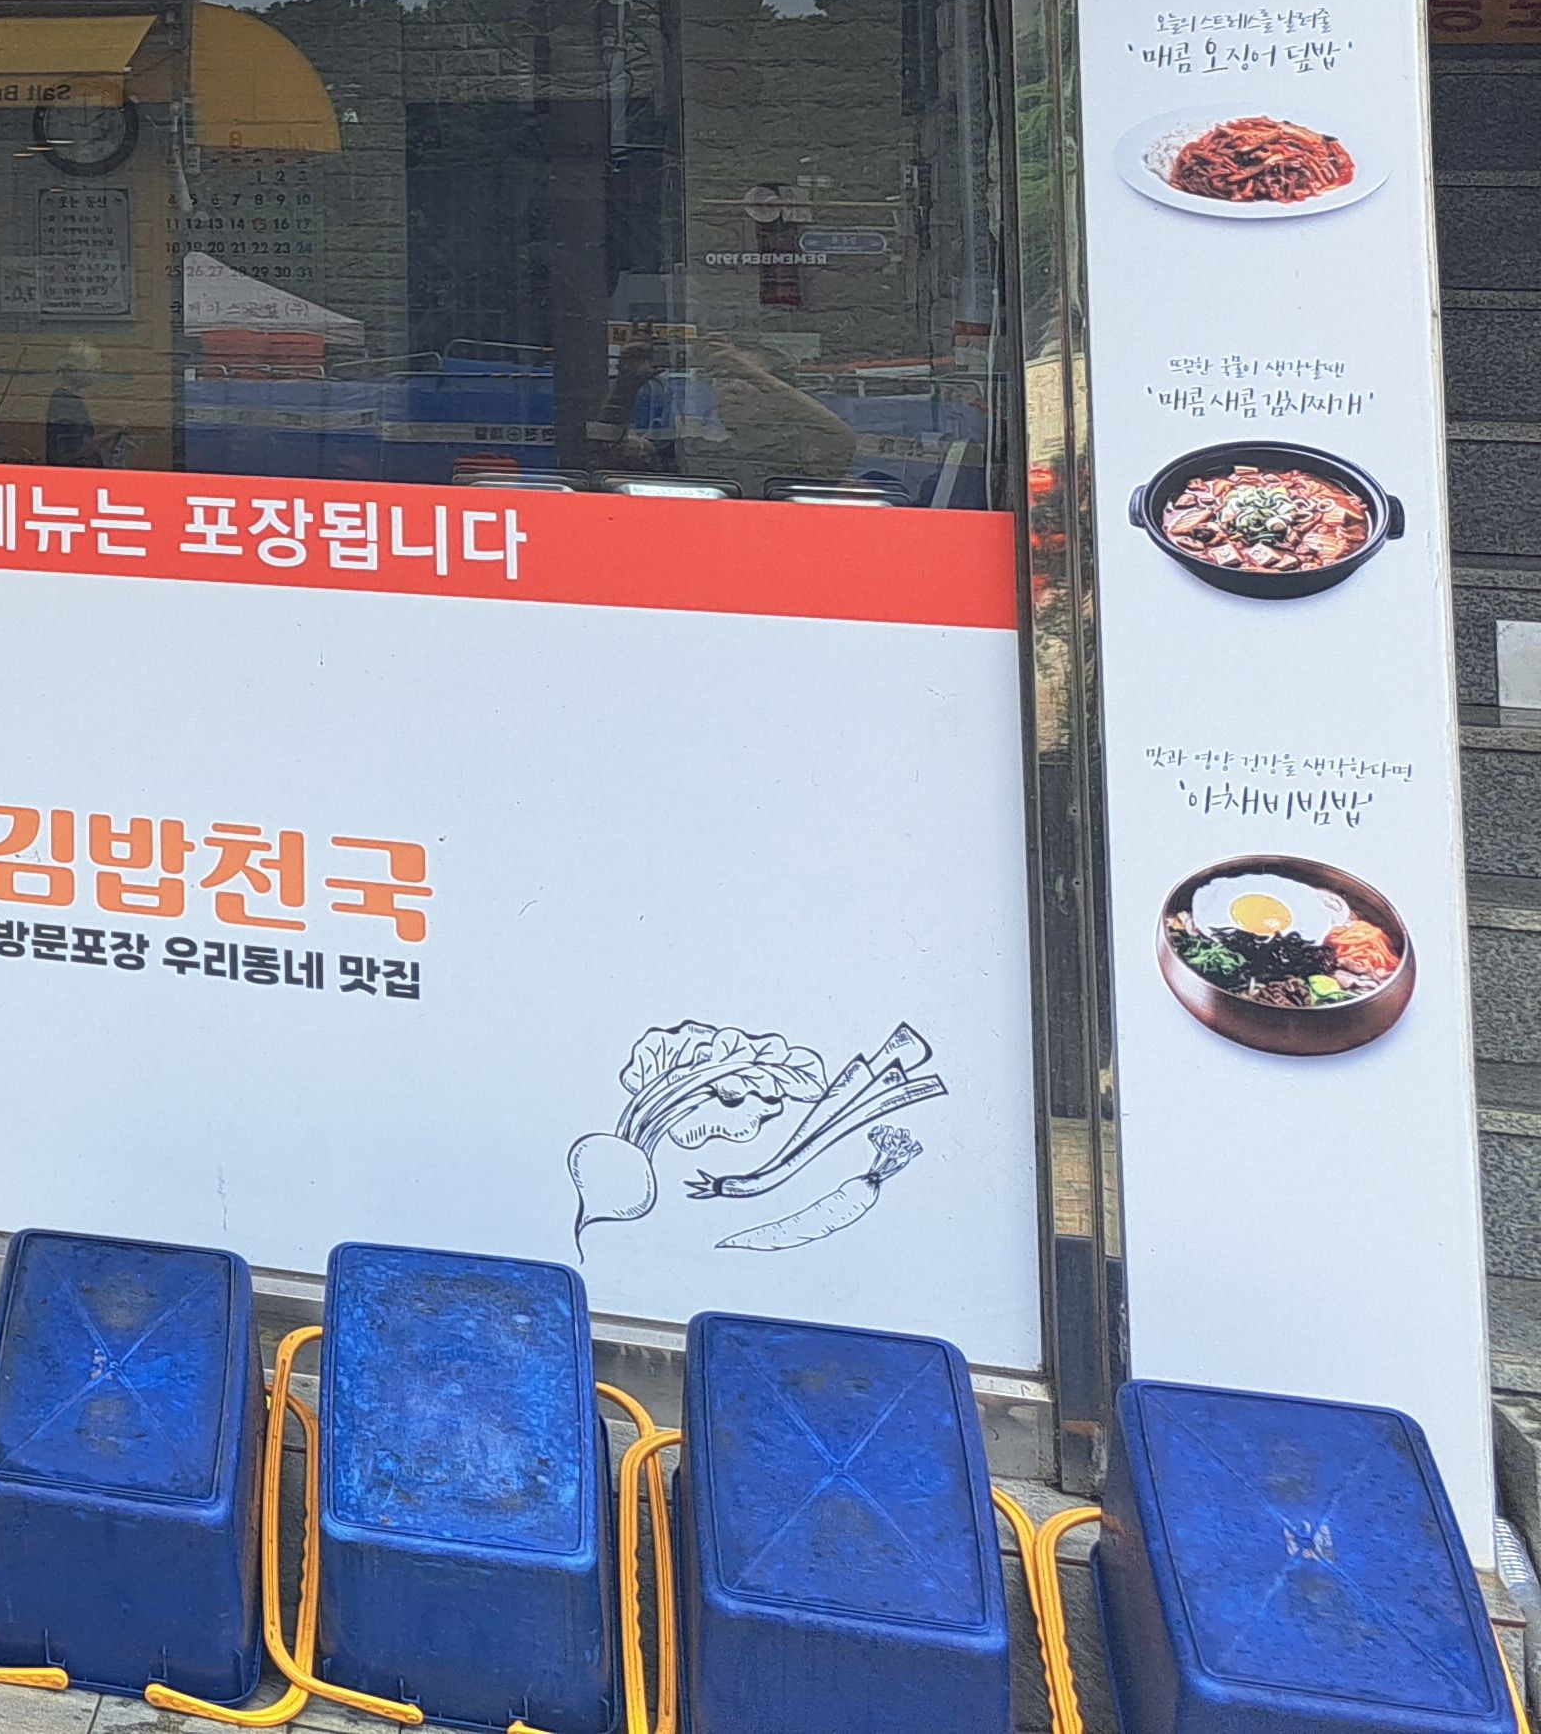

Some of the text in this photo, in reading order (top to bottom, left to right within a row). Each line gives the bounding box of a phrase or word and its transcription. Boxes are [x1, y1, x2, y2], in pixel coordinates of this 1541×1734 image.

[1155, 12, 1196, 35] 오늘의
[1199, 7, 1274, 35] 스트레스를
[1219, 354, 1258, 379] 국물이
[178, 493, 528, 580] 포장됩니다
[1145, 745, 1413, 783] 맛과 영양 건강을 생각한다면
[161, 935, 324, 991] 우리동네
[337, 954, 423, 1001] 맛집
